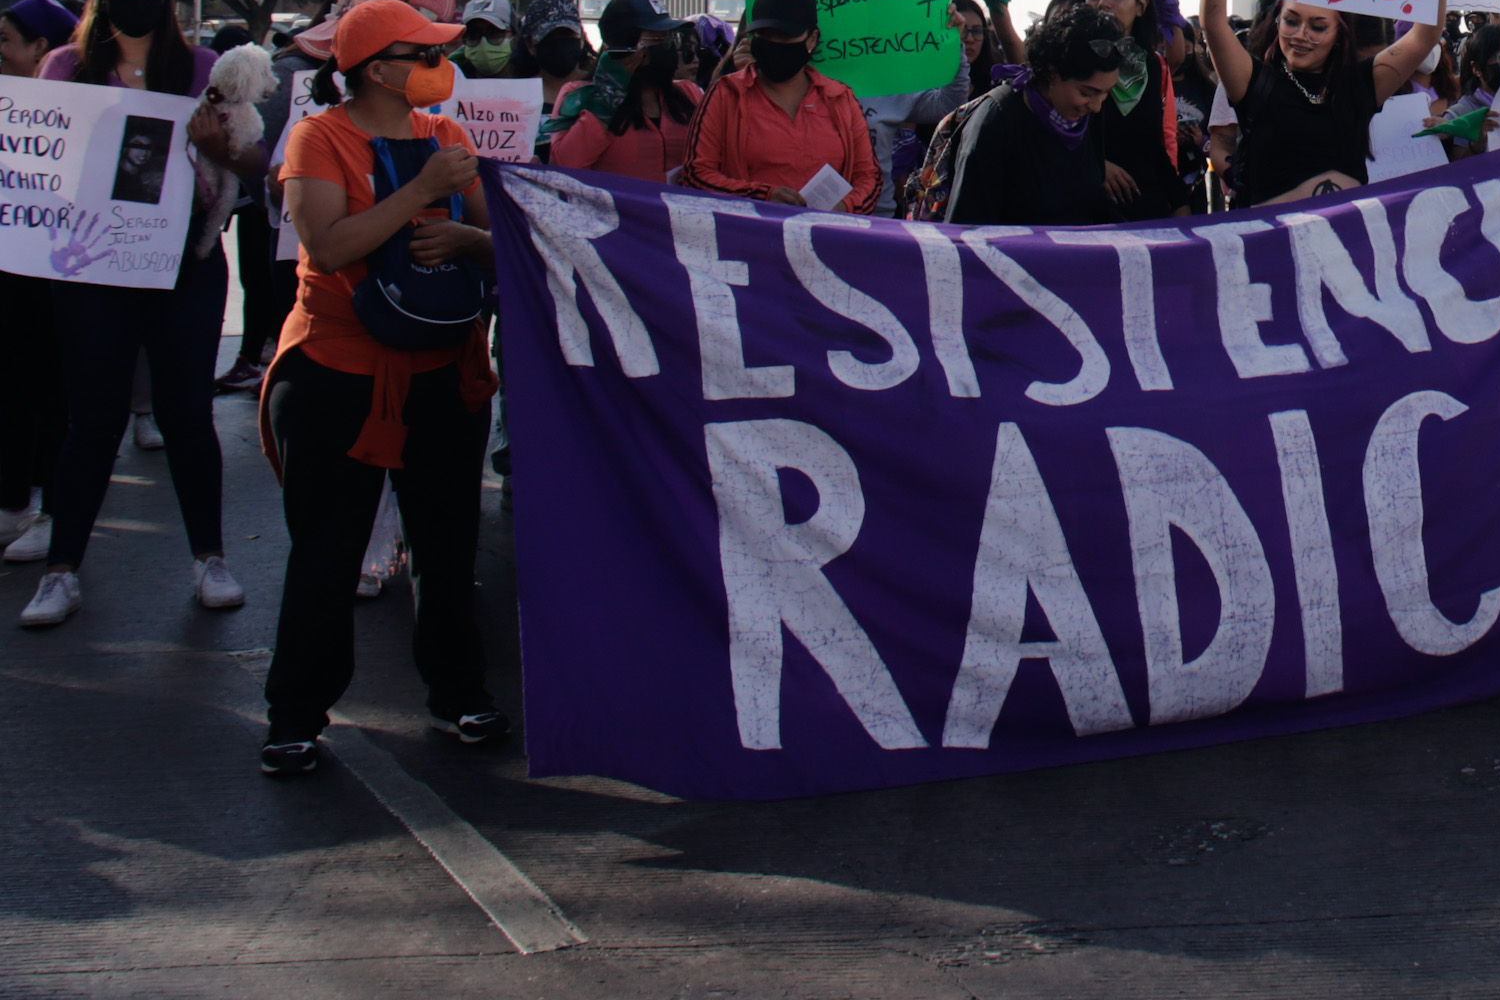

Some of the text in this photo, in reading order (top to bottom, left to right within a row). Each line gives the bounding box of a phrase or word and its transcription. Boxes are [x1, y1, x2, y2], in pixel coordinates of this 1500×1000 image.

[456, 101, 520, 122] Alzo mi
[0, 133, 65, 161] LVIDO
[470, 129, 517, 150] VOZ
[0, 168, 62, 192] ACHITO
[108, 205, 168, 229] SERGIO
[107, 231, 152, 246] JULIAN
[107, 250, 180, 273] ABUSADOR
